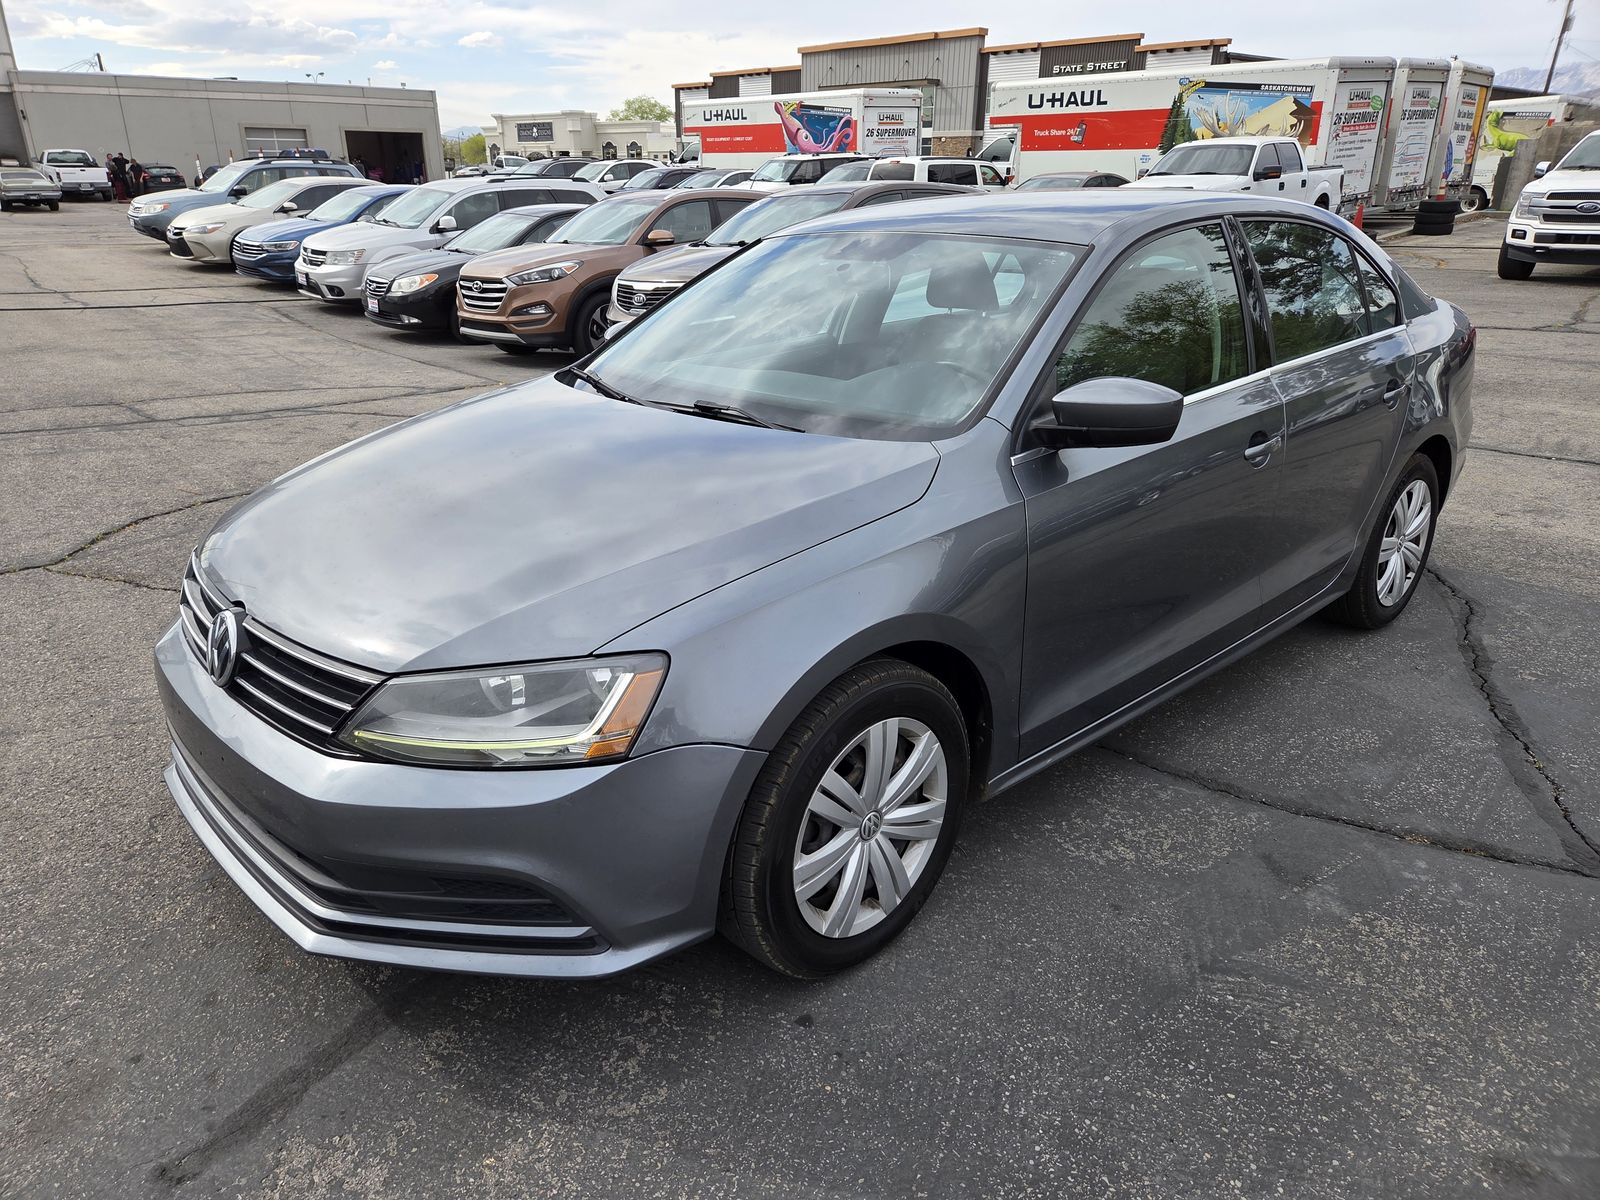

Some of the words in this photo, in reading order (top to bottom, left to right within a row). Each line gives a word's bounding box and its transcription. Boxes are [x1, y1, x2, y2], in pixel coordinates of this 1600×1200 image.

[1052, 64, 1083, 74] STATE
[1086, 61, 1127, 71] STREET
[1259, 84, 1312, 92] SASKATCHEWAN
[1028, 89, 1108, 109] U-HAUL
[703, 108, 747, 122] U-HAUL
[876, 127, 916, 137] SUPERMOVER
[1034, 129, 1050, 137] Truck
[1050, 128, 1066, 136] Share
